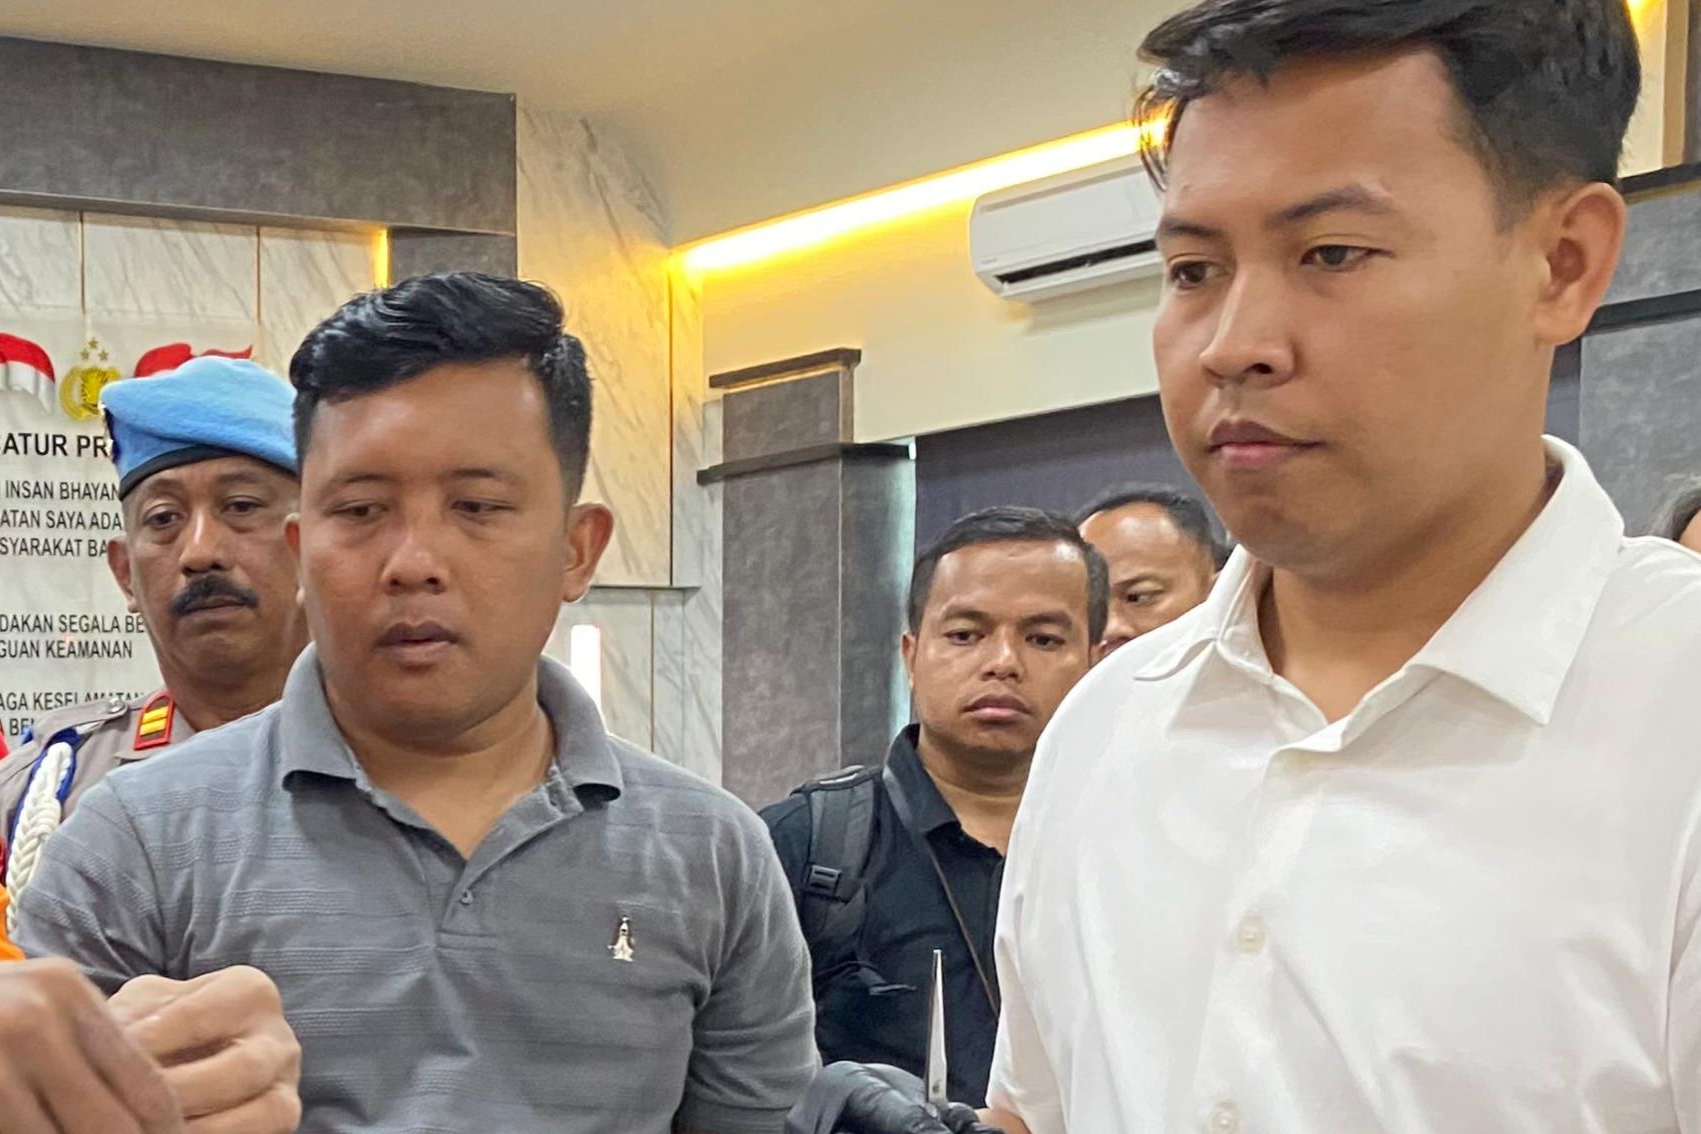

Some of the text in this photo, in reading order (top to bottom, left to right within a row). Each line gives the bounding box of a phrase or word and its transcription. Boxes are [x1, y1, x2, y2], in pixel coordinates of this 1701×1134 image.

[5, 479, 54, 499] INSAN
[45, 510, 87, 530] SAYA
[90, 512, 123, 531] ADA
[58, 614, 121, 633] SEGALA
[46, 640, 133, 659] KEAMANAN
